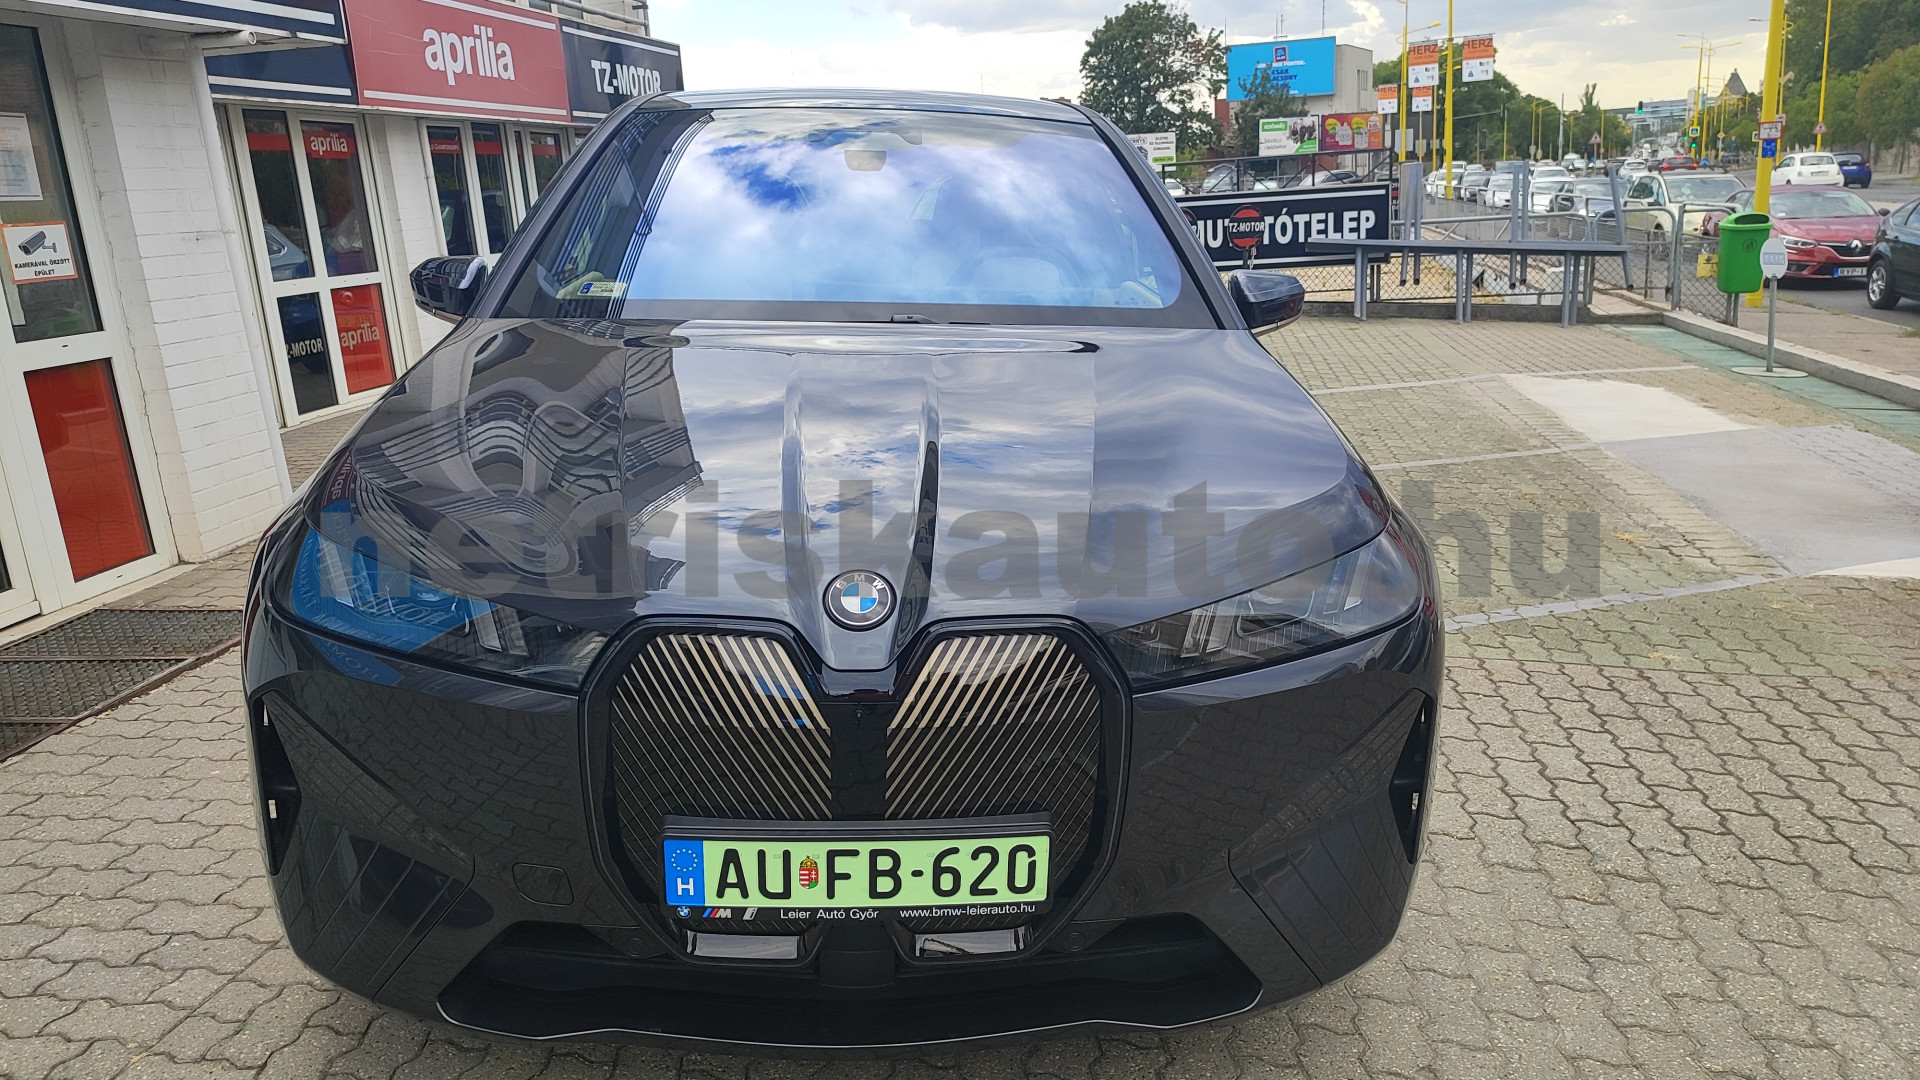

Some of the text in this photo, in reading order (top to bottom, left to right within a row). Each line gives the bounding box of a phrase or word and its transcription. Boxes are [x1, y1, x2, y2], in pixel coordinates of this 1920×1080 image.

[1408, 44, 1438, 56] HERZ
[1463, 38, 1493, 49] HERZ
[422, 24, 515, 86] aprilia
[590, 59, 661, 97] TZ-MOTOR
[310, 133, 348, 156] aprilia
[1229, 221, 1265, 233] TZ-MOTOR
[15, 260, 49, 269] KAMERÁVAL
[340, 322, 380, 351] aprilia
[285, 338, 324, 359] Z-MOTOR
[836, 574, 885, 590] BMW
[716, 844, 1036, 899] AU FB-620
[677, 877, 694, 896] H
[780, 908, 811, 919] Leier
[816, 907, 846, 919] Autó
[850, 907, 879, 921] Győr
[900, 903, 1036, 918] www.bmw-leierauto.hu
